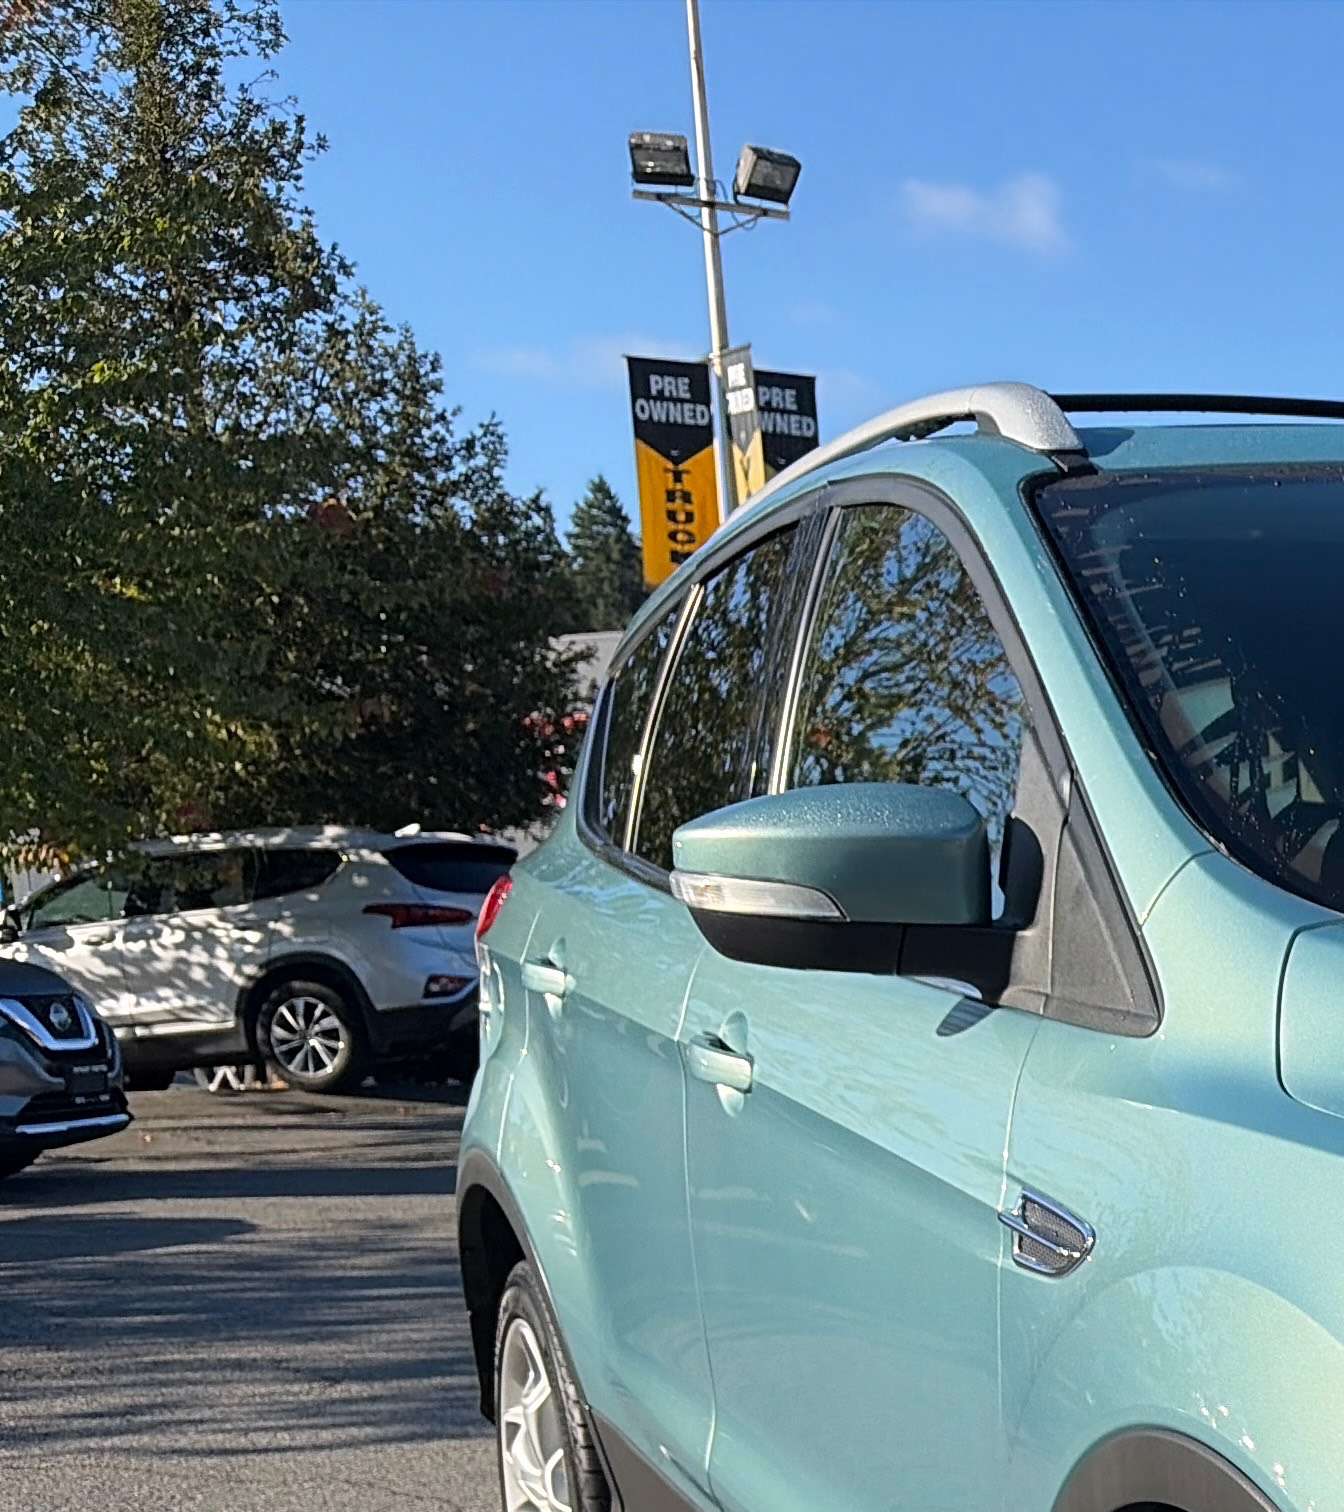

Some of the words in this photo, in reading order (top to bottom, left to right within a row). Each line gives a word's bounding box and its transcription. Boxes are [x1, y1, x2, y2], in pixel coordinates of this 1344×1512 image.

[649, 374, 691, 399] PRE
[757, 385, 798, 410] PRE
[635, 398, 710, 426] OWNED
[756, 411, 815, 437] WNED
